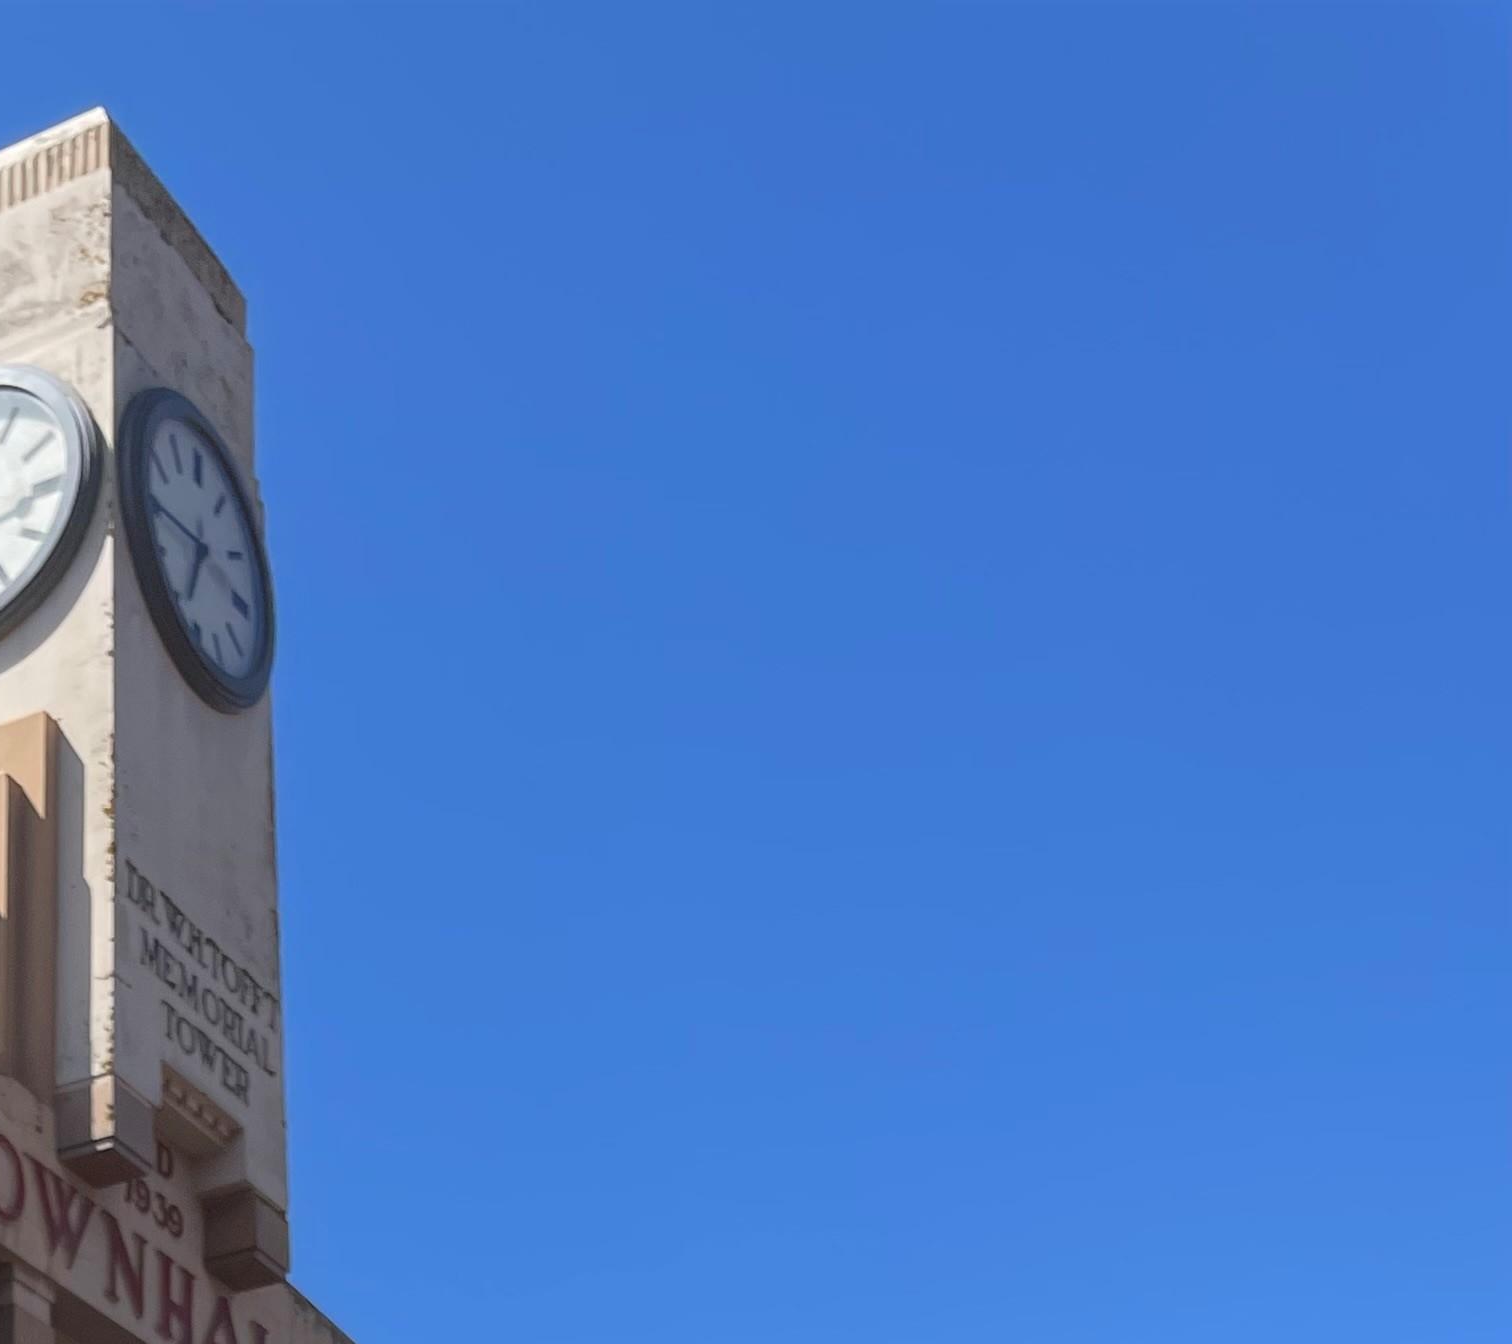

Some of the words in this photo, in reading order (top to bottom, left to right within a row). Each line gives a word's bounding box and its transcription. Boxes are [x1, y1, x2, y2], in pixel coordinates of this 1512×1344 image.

[139, 926, 276, 1078] MEMORIAL
[160, 998, 249, 1108] TOWER
[123, 1178, 185, 1239] 1939
